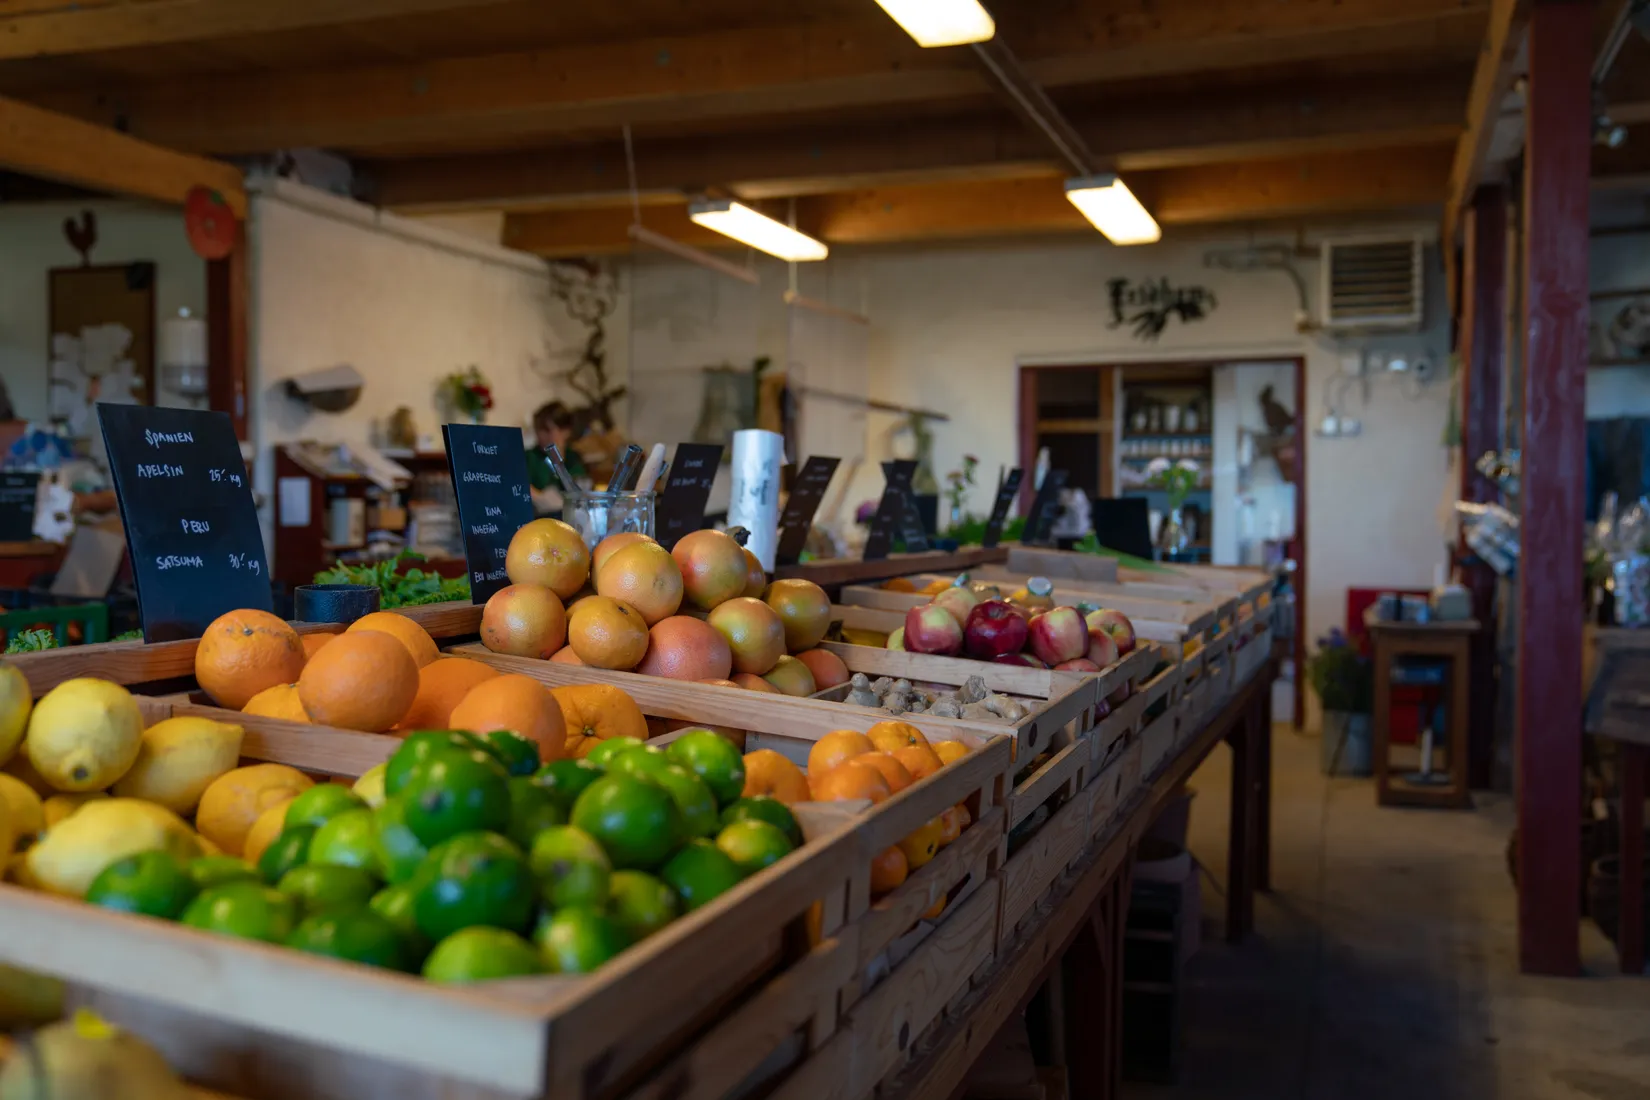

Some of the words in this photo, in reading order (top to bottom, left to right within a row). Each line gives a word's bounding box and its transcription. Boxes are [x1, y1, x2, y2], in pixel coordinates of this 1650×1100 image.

[145, 428, 194, 449] SPANIEN
[137, 463, 184, 478] APELSIN
[181, 518, 210, 534] PERU
[494, 547, 508, 559] PER
[156, 554, 204, 570] SATSUMA
